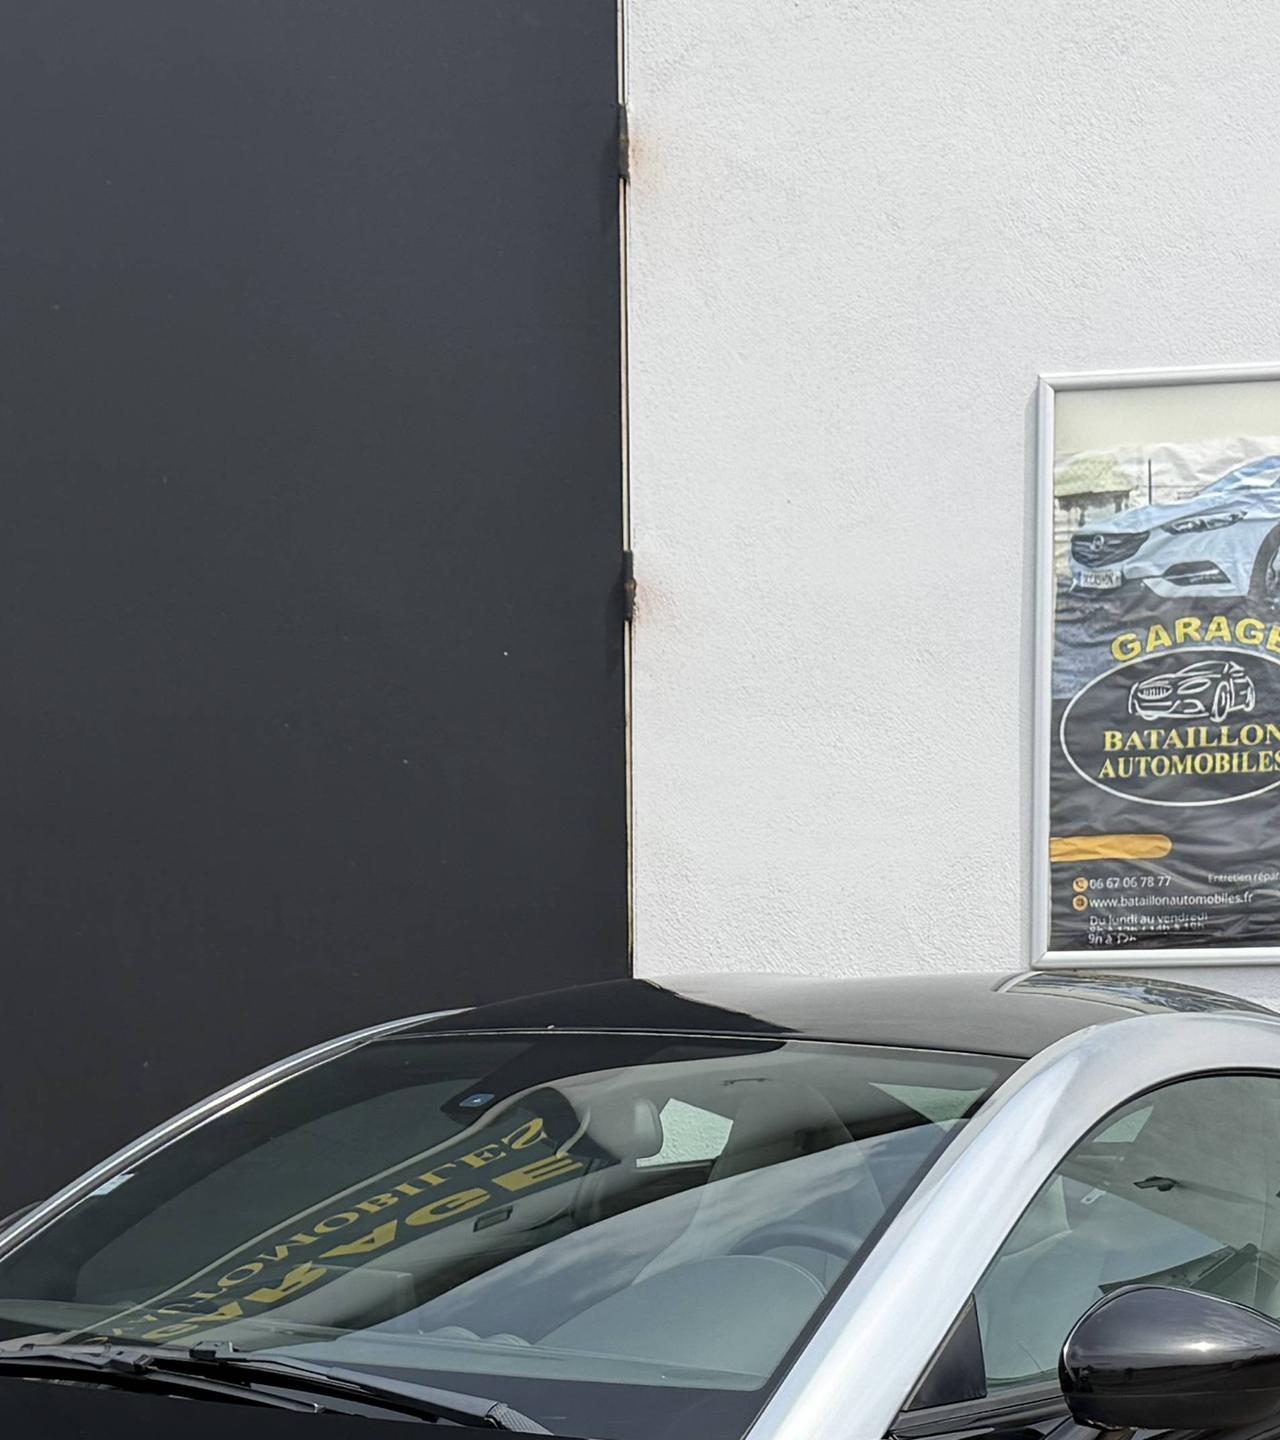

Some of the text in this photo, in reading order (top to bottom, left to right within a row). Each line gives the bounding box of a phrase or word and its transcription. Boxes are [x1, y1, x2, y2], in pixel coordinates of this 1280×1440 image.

[1089, 875, 1172, 889] 06 67 06 78 77
[1208, 873, 1252, 883] Entretien
[1089, 891, 1254, 908] www.bataillonautomobiles.fr
[1089, 911, 1209, 927] Du lundi au vendredi
